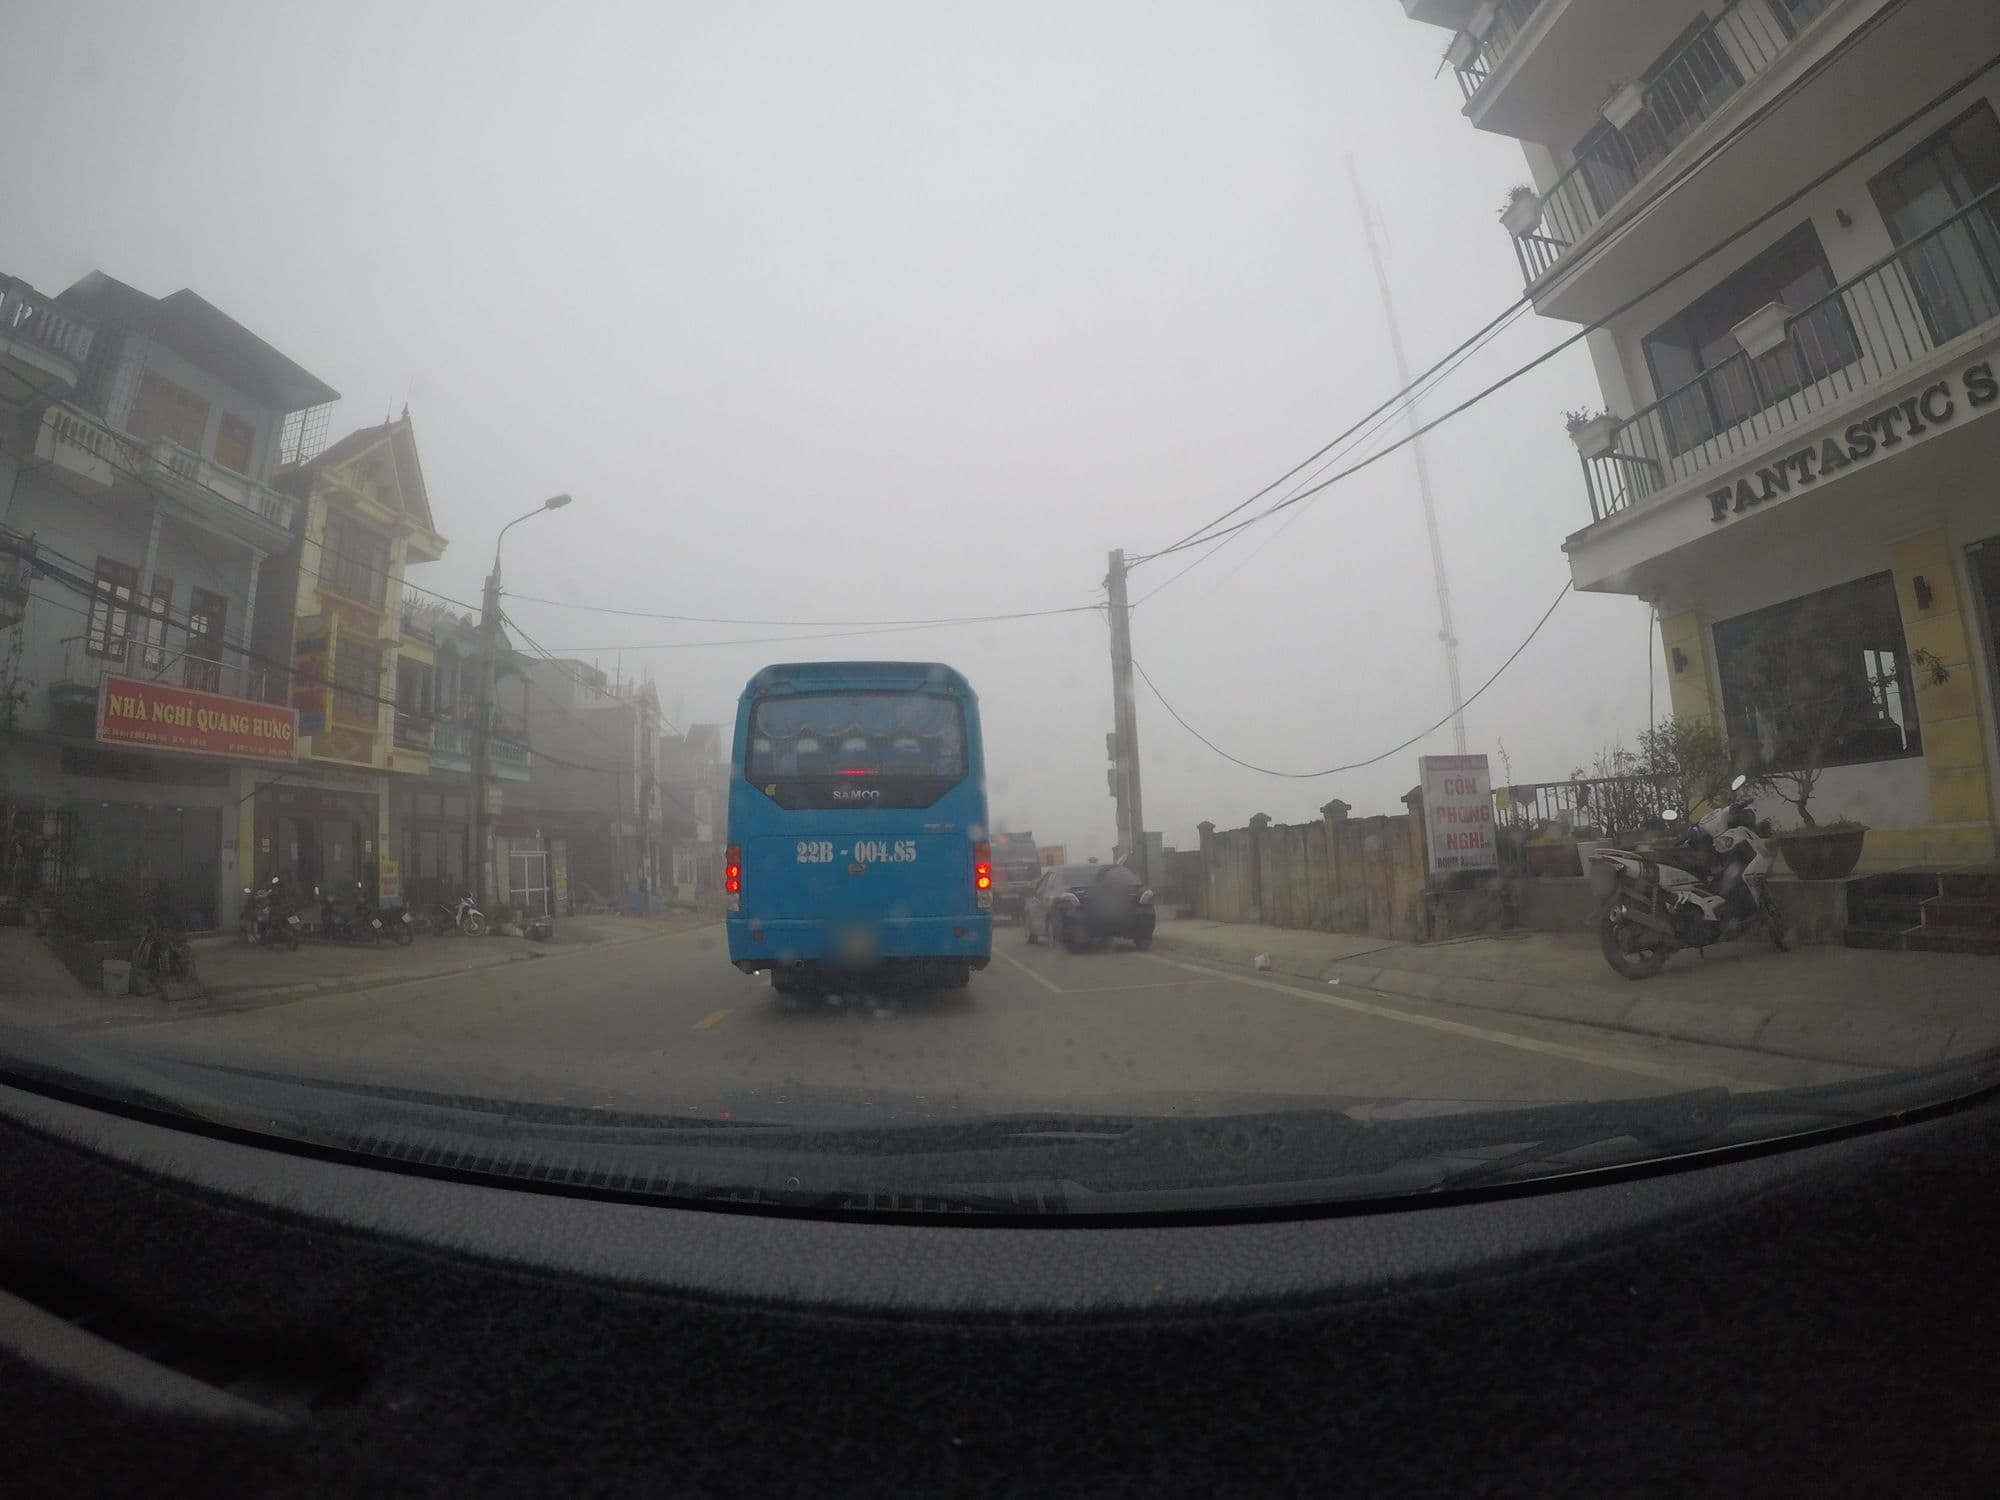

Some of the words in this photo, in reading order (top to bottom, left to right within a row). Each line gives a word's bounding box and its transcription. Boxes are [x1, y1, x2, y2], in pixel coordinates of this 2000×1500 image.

[1706, 381, 1955, 521] FANTASTIC
[109, 692, 147, 721] NHÀ
[197, 708, 249, 735] QUANG
[832, 789, 880, 800] SAMCO
[1445, 774, 1478, 795] CÒN
[796, 840, 834, 864] 22B
[854, 840, 918, 864] 004.85
